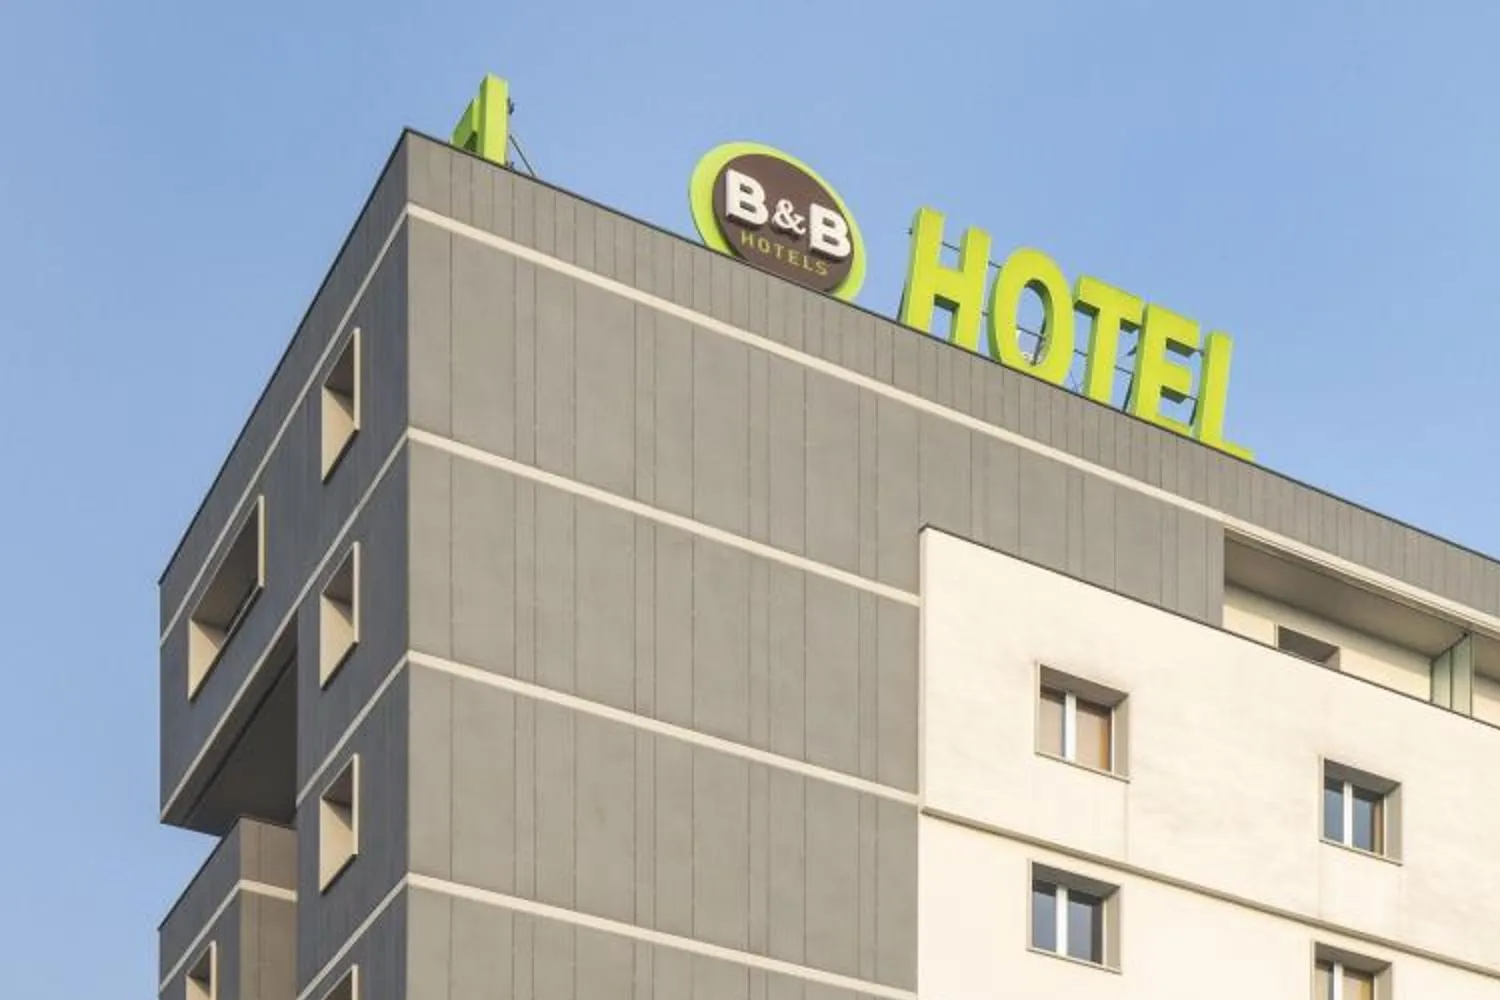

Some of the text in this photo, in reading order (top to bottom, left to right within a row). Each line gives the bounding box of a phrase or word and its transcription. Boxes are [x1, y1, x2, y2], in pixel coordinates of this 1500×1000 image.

[725, 168, 851, 258] B&B
[740, 230, 829, 277] HOTELS
[903, 205, 1256, 461] HOTEL
